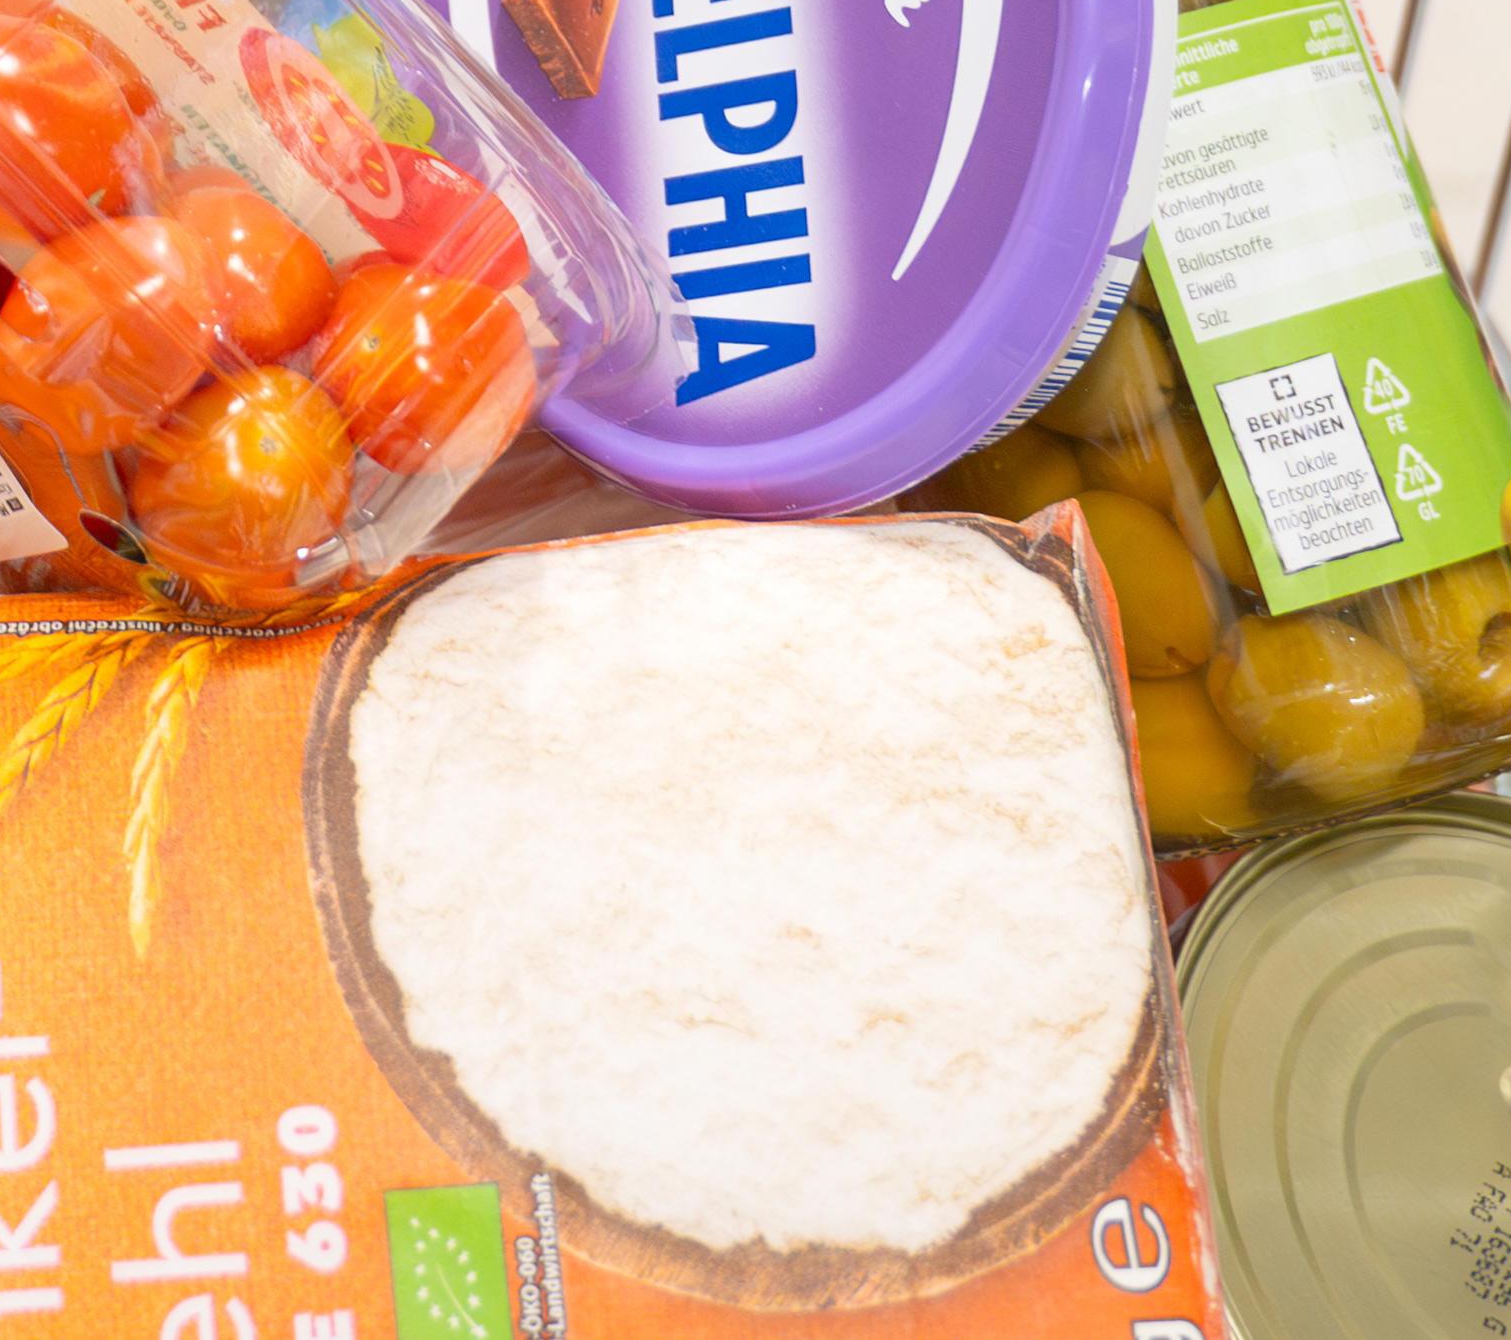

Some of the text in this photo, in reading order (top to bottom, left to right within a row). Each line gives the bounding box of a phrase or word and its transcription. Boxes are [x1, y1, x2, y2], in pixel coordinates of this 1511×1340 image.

[1199, 128, 1270, 162] gesättigte
[1157, 179, 1266, 220] Kohlenhydrate
[1175, 205, 1271, 243] davon Zucker
[1177, 235, 1274, 274] Ballaststoffe
[1187, 272, 1238, 301] Eiweiß
[1197, 309, 1231, 330] Salz
[1247, 394, 1335, 433] BEWUSST
[1385, 413, 1408, 435] FE
[1254, 415, 1345, 453] TRENNEN
[1285, 450, 1338, 478] Lokale
[1267, 468, 1369, 509] Entsorgungs-
[1273, 488, 1381, 532] möglichkeiten
[1417, 500, 1441, 522] GL
[1298, 515, 1375, 550] beachten
[278, 1106, 347, 1275] 630
[1470, 1182, 1506, 1223] FAO
[532, 1174, 566, 1340] -Landwirtschaft
